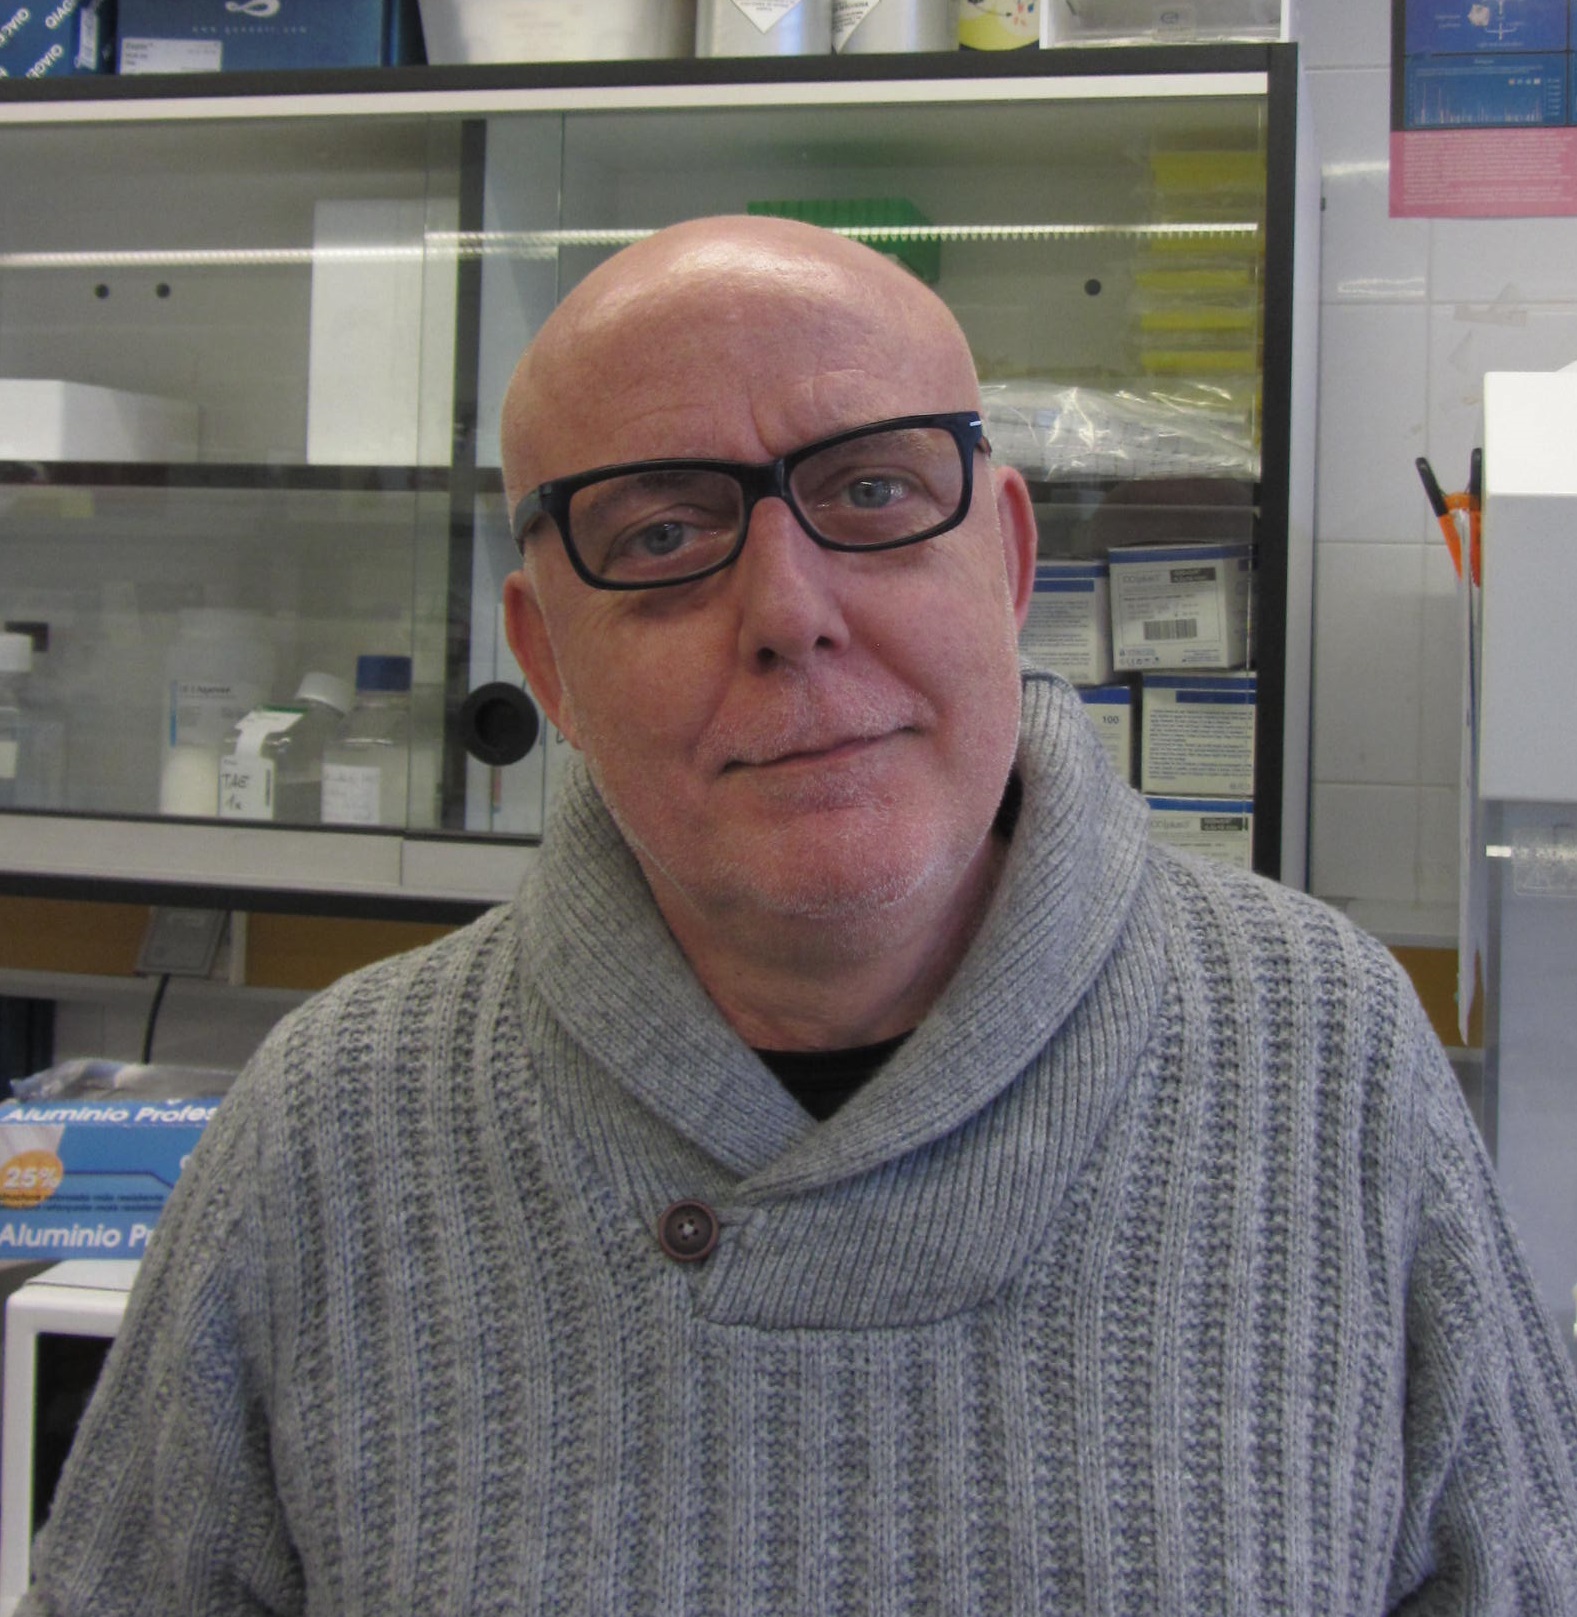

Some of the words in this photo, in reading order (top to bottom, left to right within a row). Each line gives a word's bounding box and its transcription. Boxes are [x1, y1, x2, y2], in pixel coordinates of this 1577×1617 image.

[1102, 715, 1120, 725] 100
[221, 773, 251, 791] TAE
[0, 1106, 130, 1123] Aluminio
[3, 1166, 59, 1190] 25%
[0, 1222, 121, 1248] Aluminio
